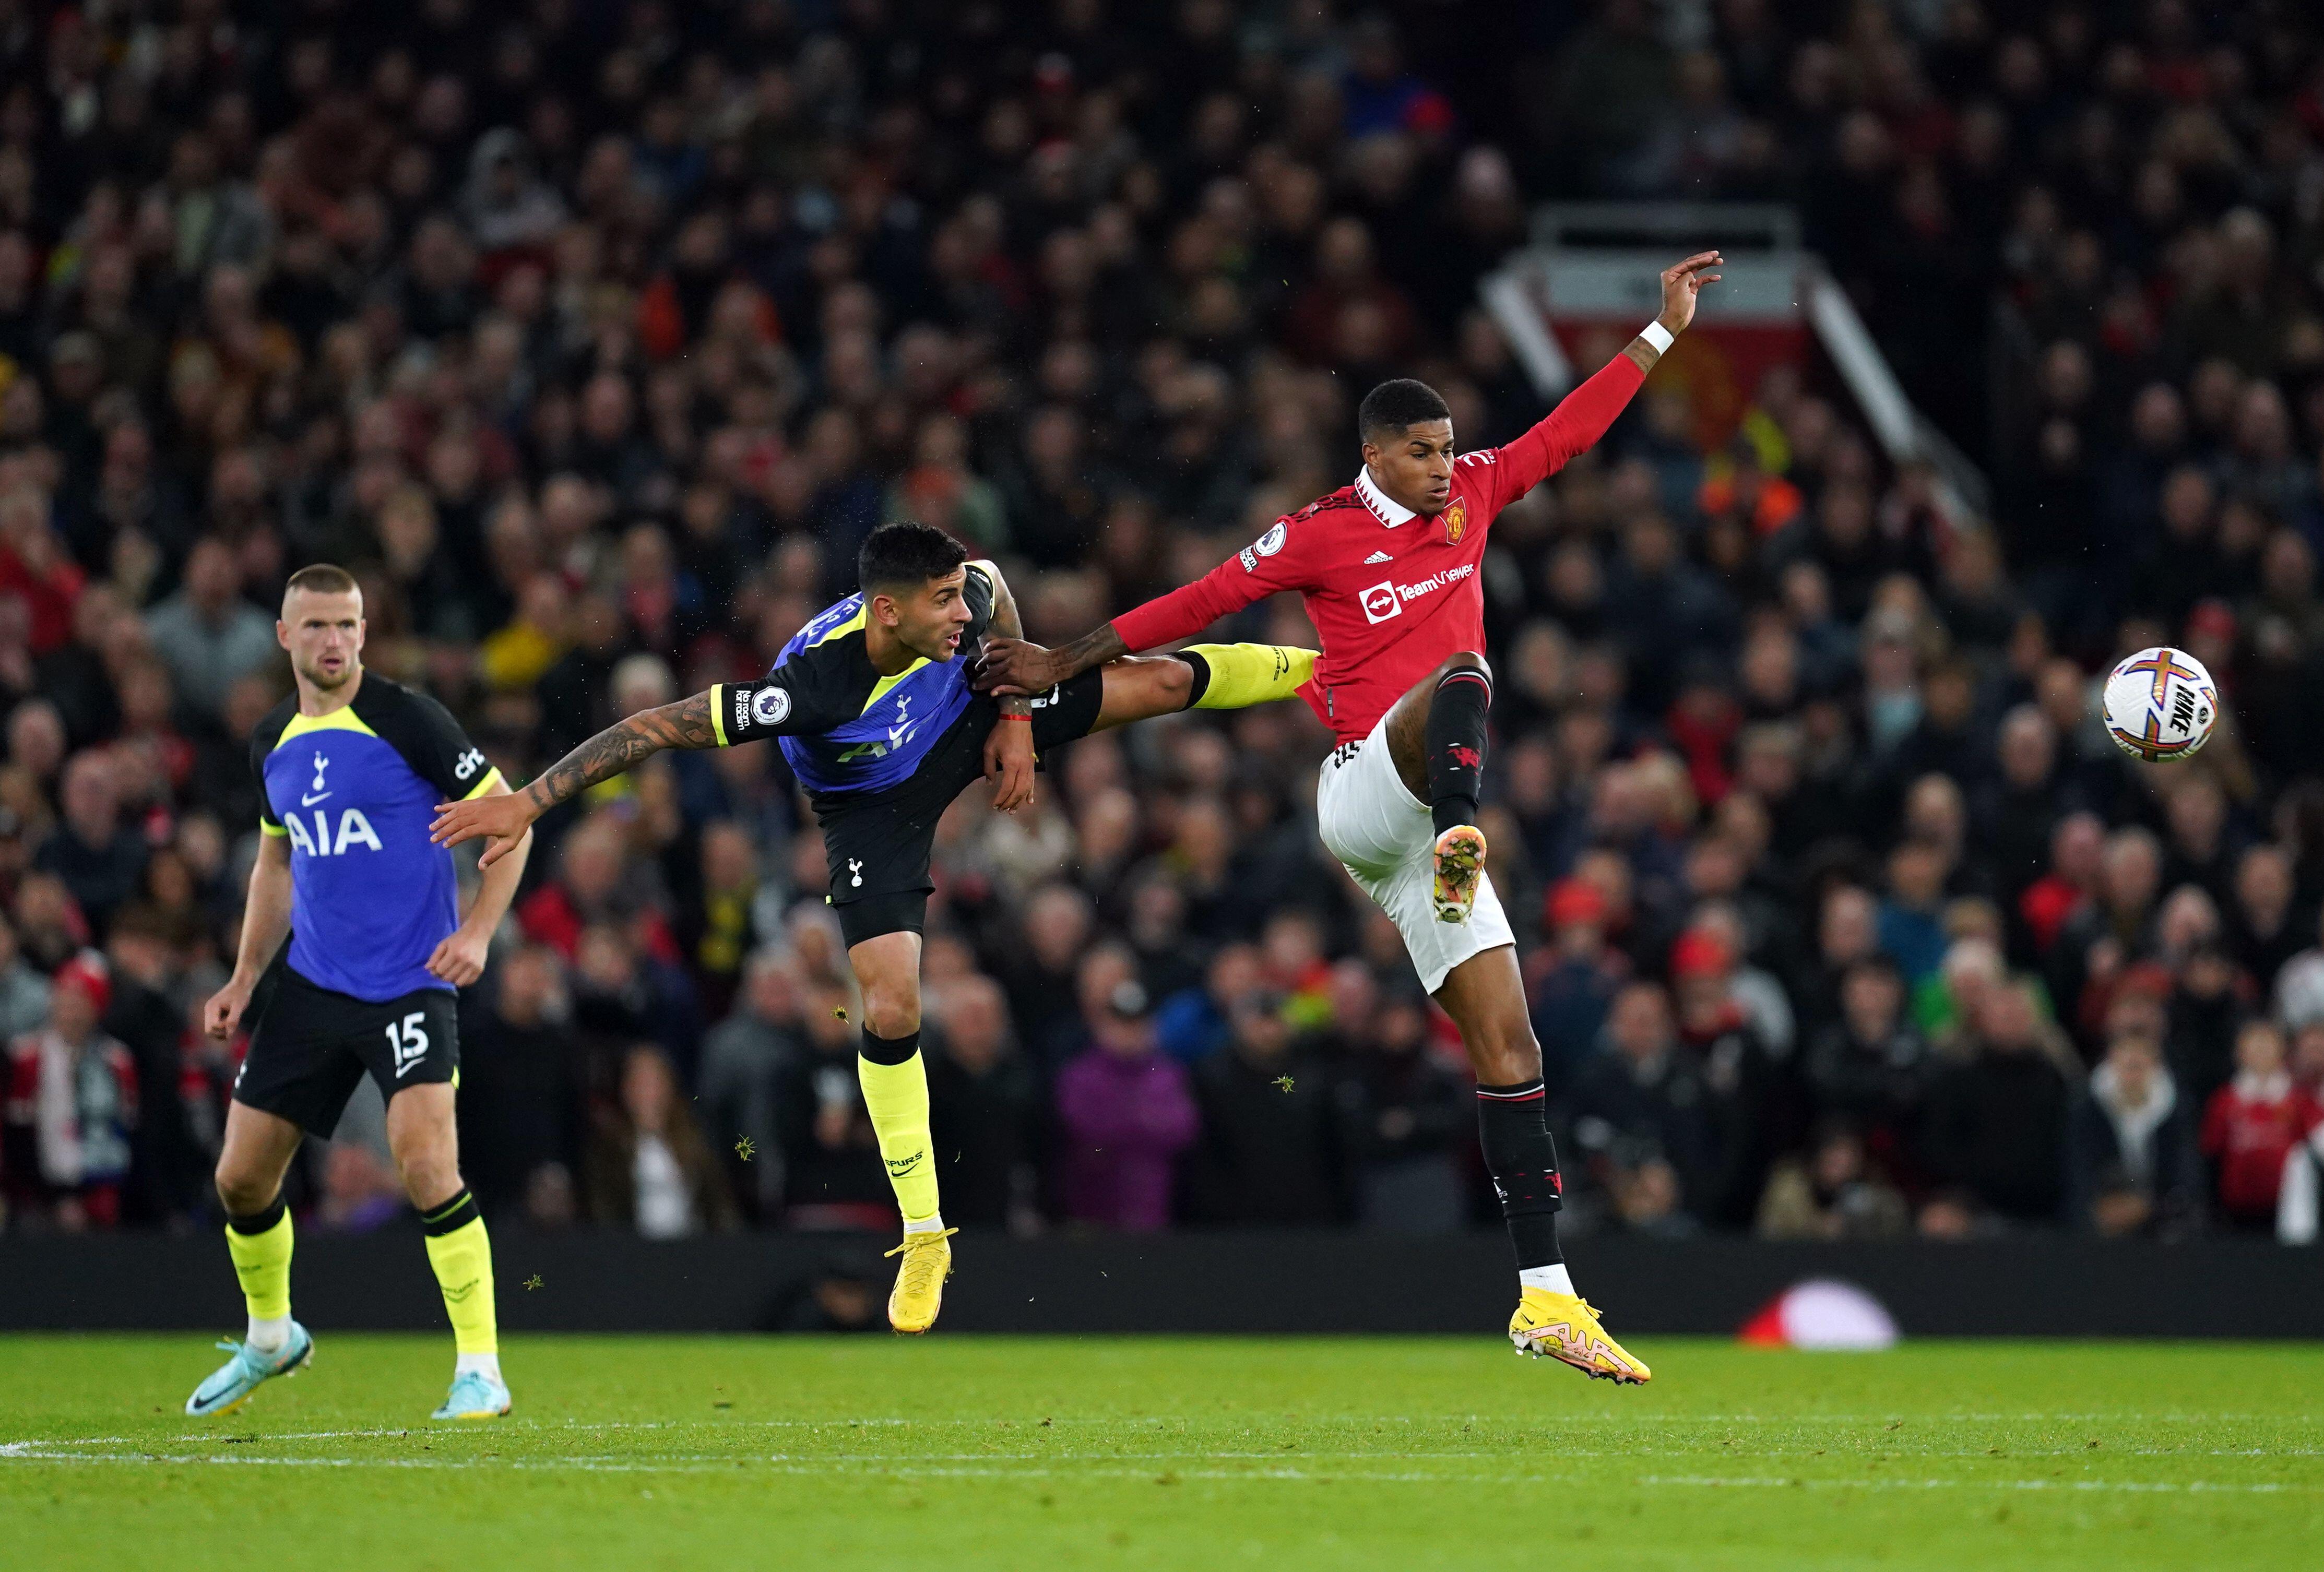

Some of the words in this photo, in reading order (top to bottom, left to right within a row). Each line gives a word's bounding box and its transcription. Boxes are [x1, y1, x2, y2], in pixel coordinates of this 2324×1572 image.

[1395, 564, 1474, 602] TeamViewer
[742, 690, 751, 702] No
[2169, 684, 2195, 736] NIKE
[736, 702, 744, 731] racism
[284, 808, 383, 857] AIA
[385, 1011, 429, 1067] 15
[885, 1151, 923, 1167] SPURS
